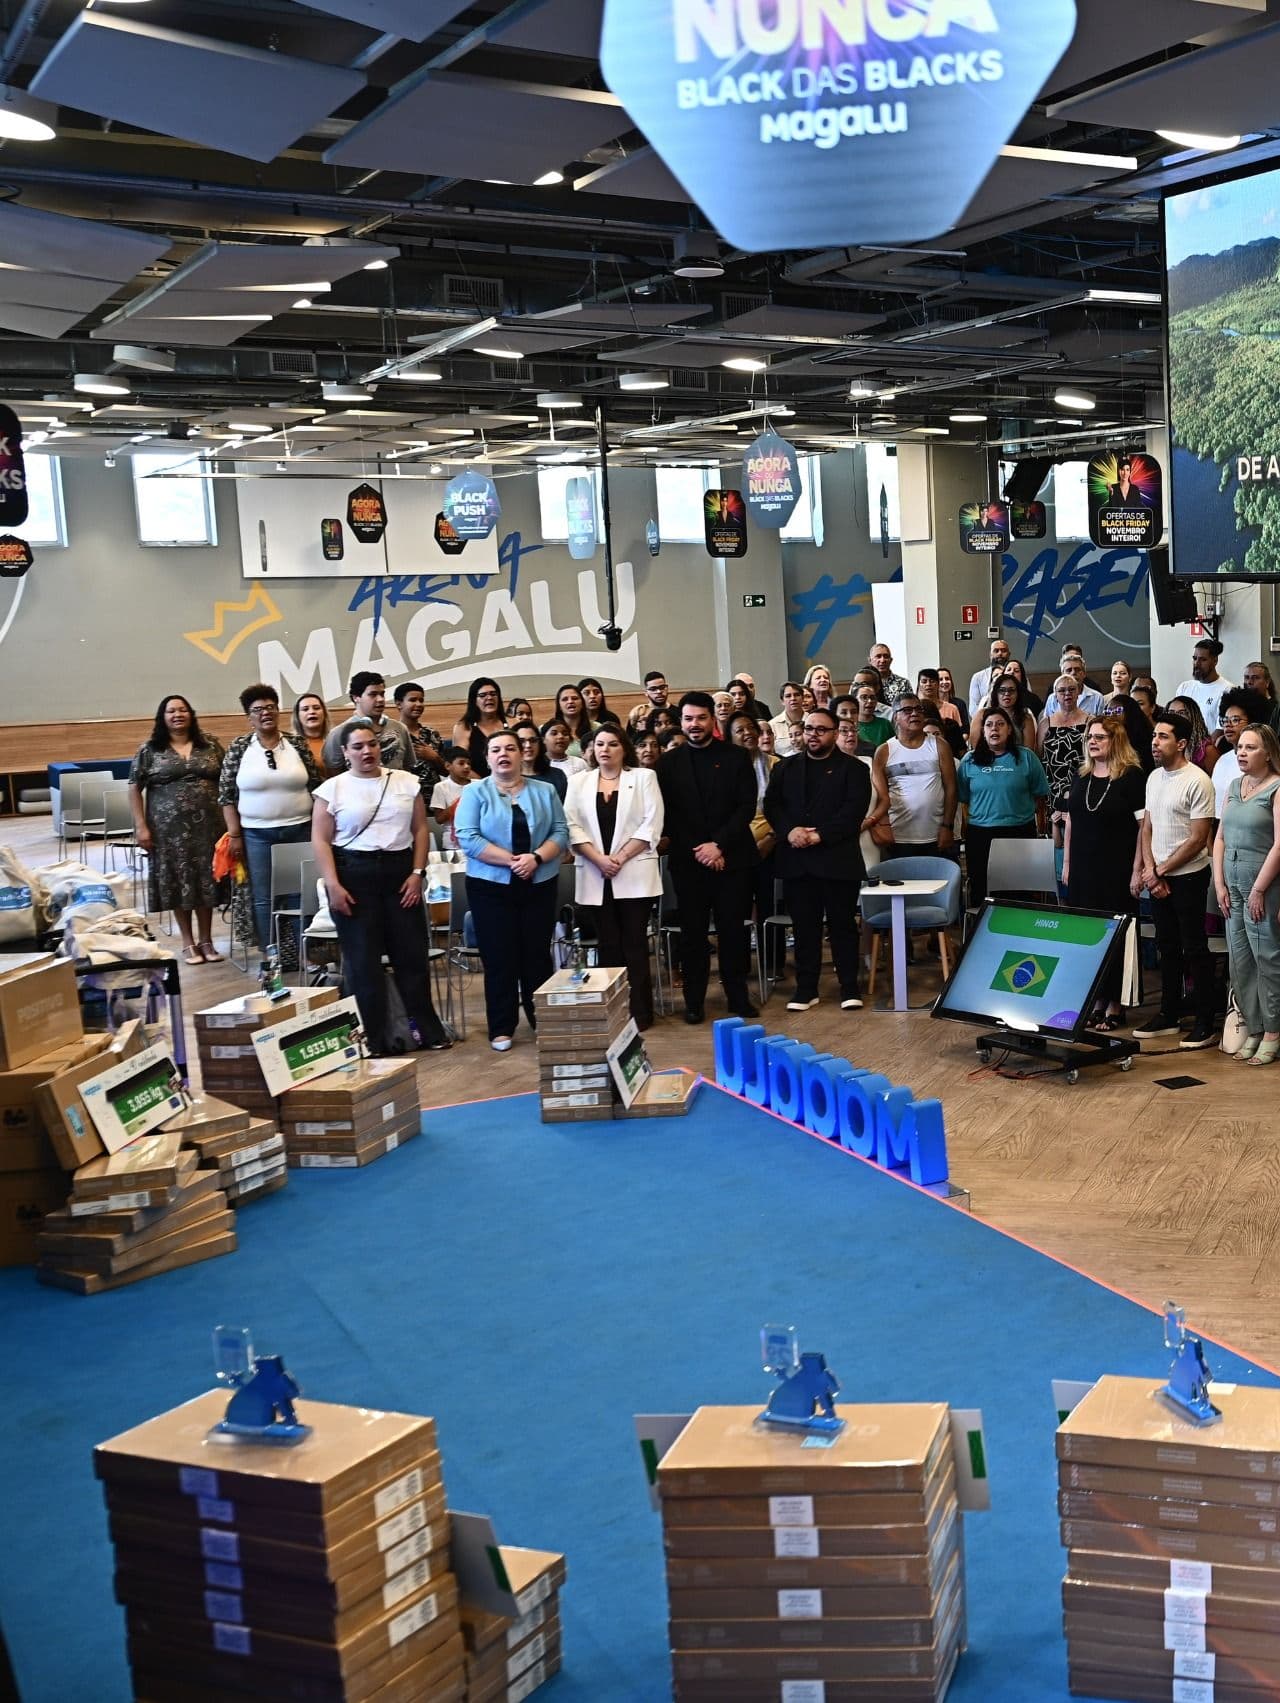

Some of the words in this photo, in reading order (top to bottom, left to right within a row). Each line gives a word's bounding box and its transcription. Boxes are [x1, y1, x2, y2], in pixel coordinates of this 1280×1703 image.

[676, 71, 786, 109] BLACK
[792, 64, 858, 98] DAS
[864, 50, 1004, 92] BLACKS
[760, 102, 908, 149] Magalu
[748, 456, 791, 472] AGORA
[1237, 456, 1262, 481] DE
[749, 478, 793, 494] NUNCA
[451, 492, 488, 503] BLACK
[453, 505, 486, 516] PUSH
[256, 562, 636, 703] MAGALU
